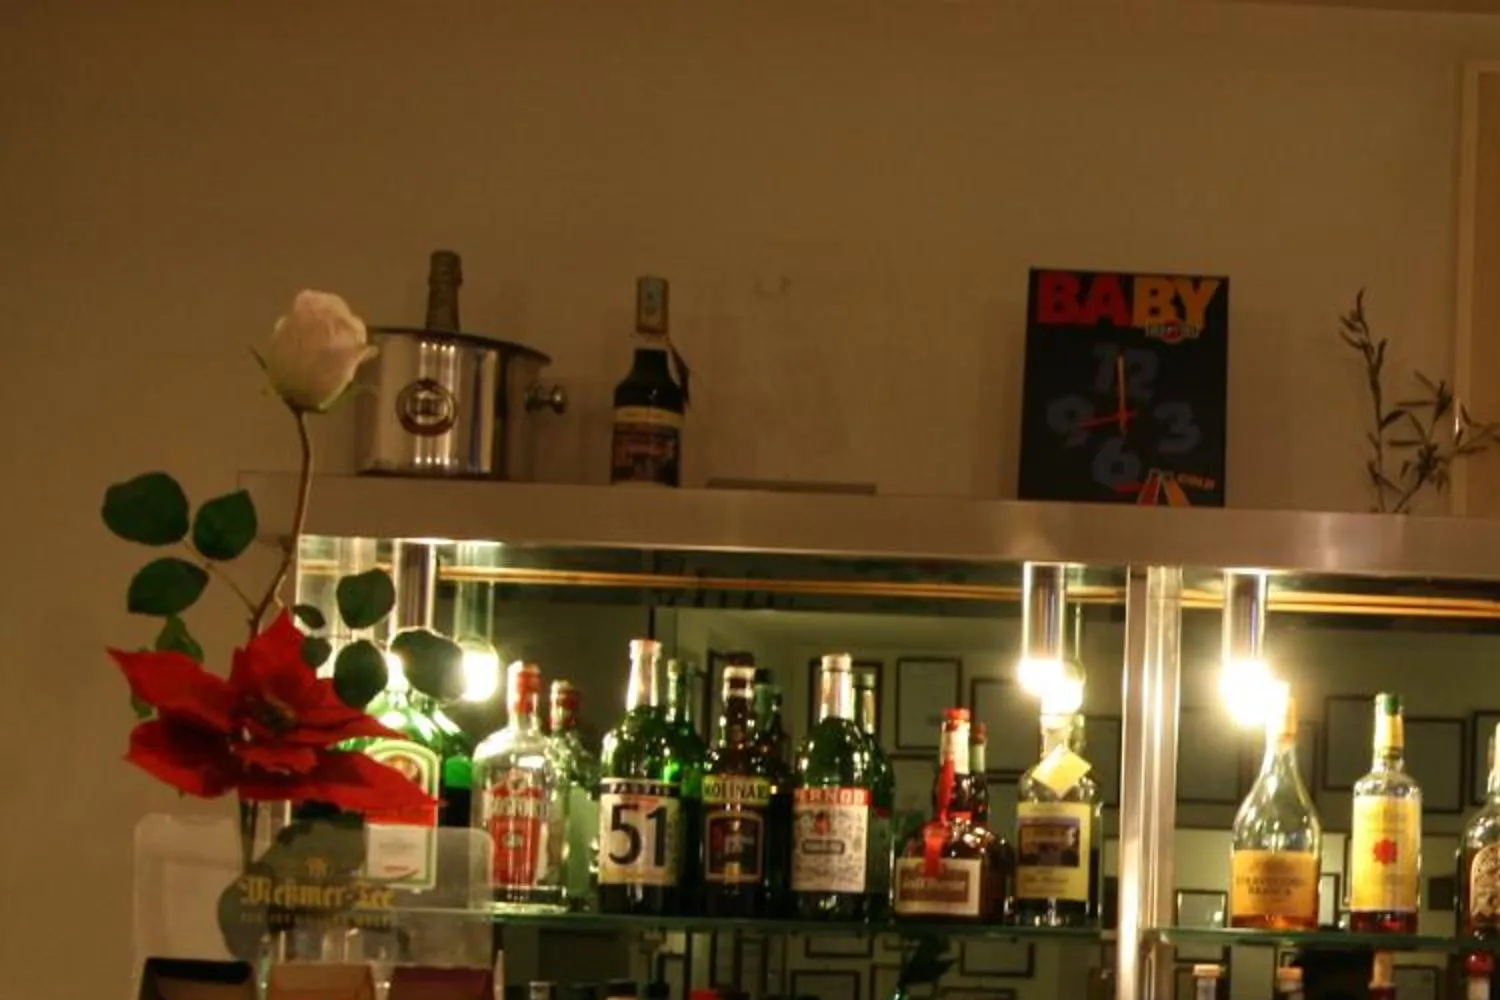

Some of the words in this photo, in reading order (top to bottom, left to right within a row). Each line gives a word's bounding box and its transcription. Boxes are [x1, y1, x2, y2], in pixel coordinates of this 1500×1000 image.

[1037, 270, 1220, 330] BABY
[1153, 401, 1203, 454] 3
[609, 803, 668, 867] 51
